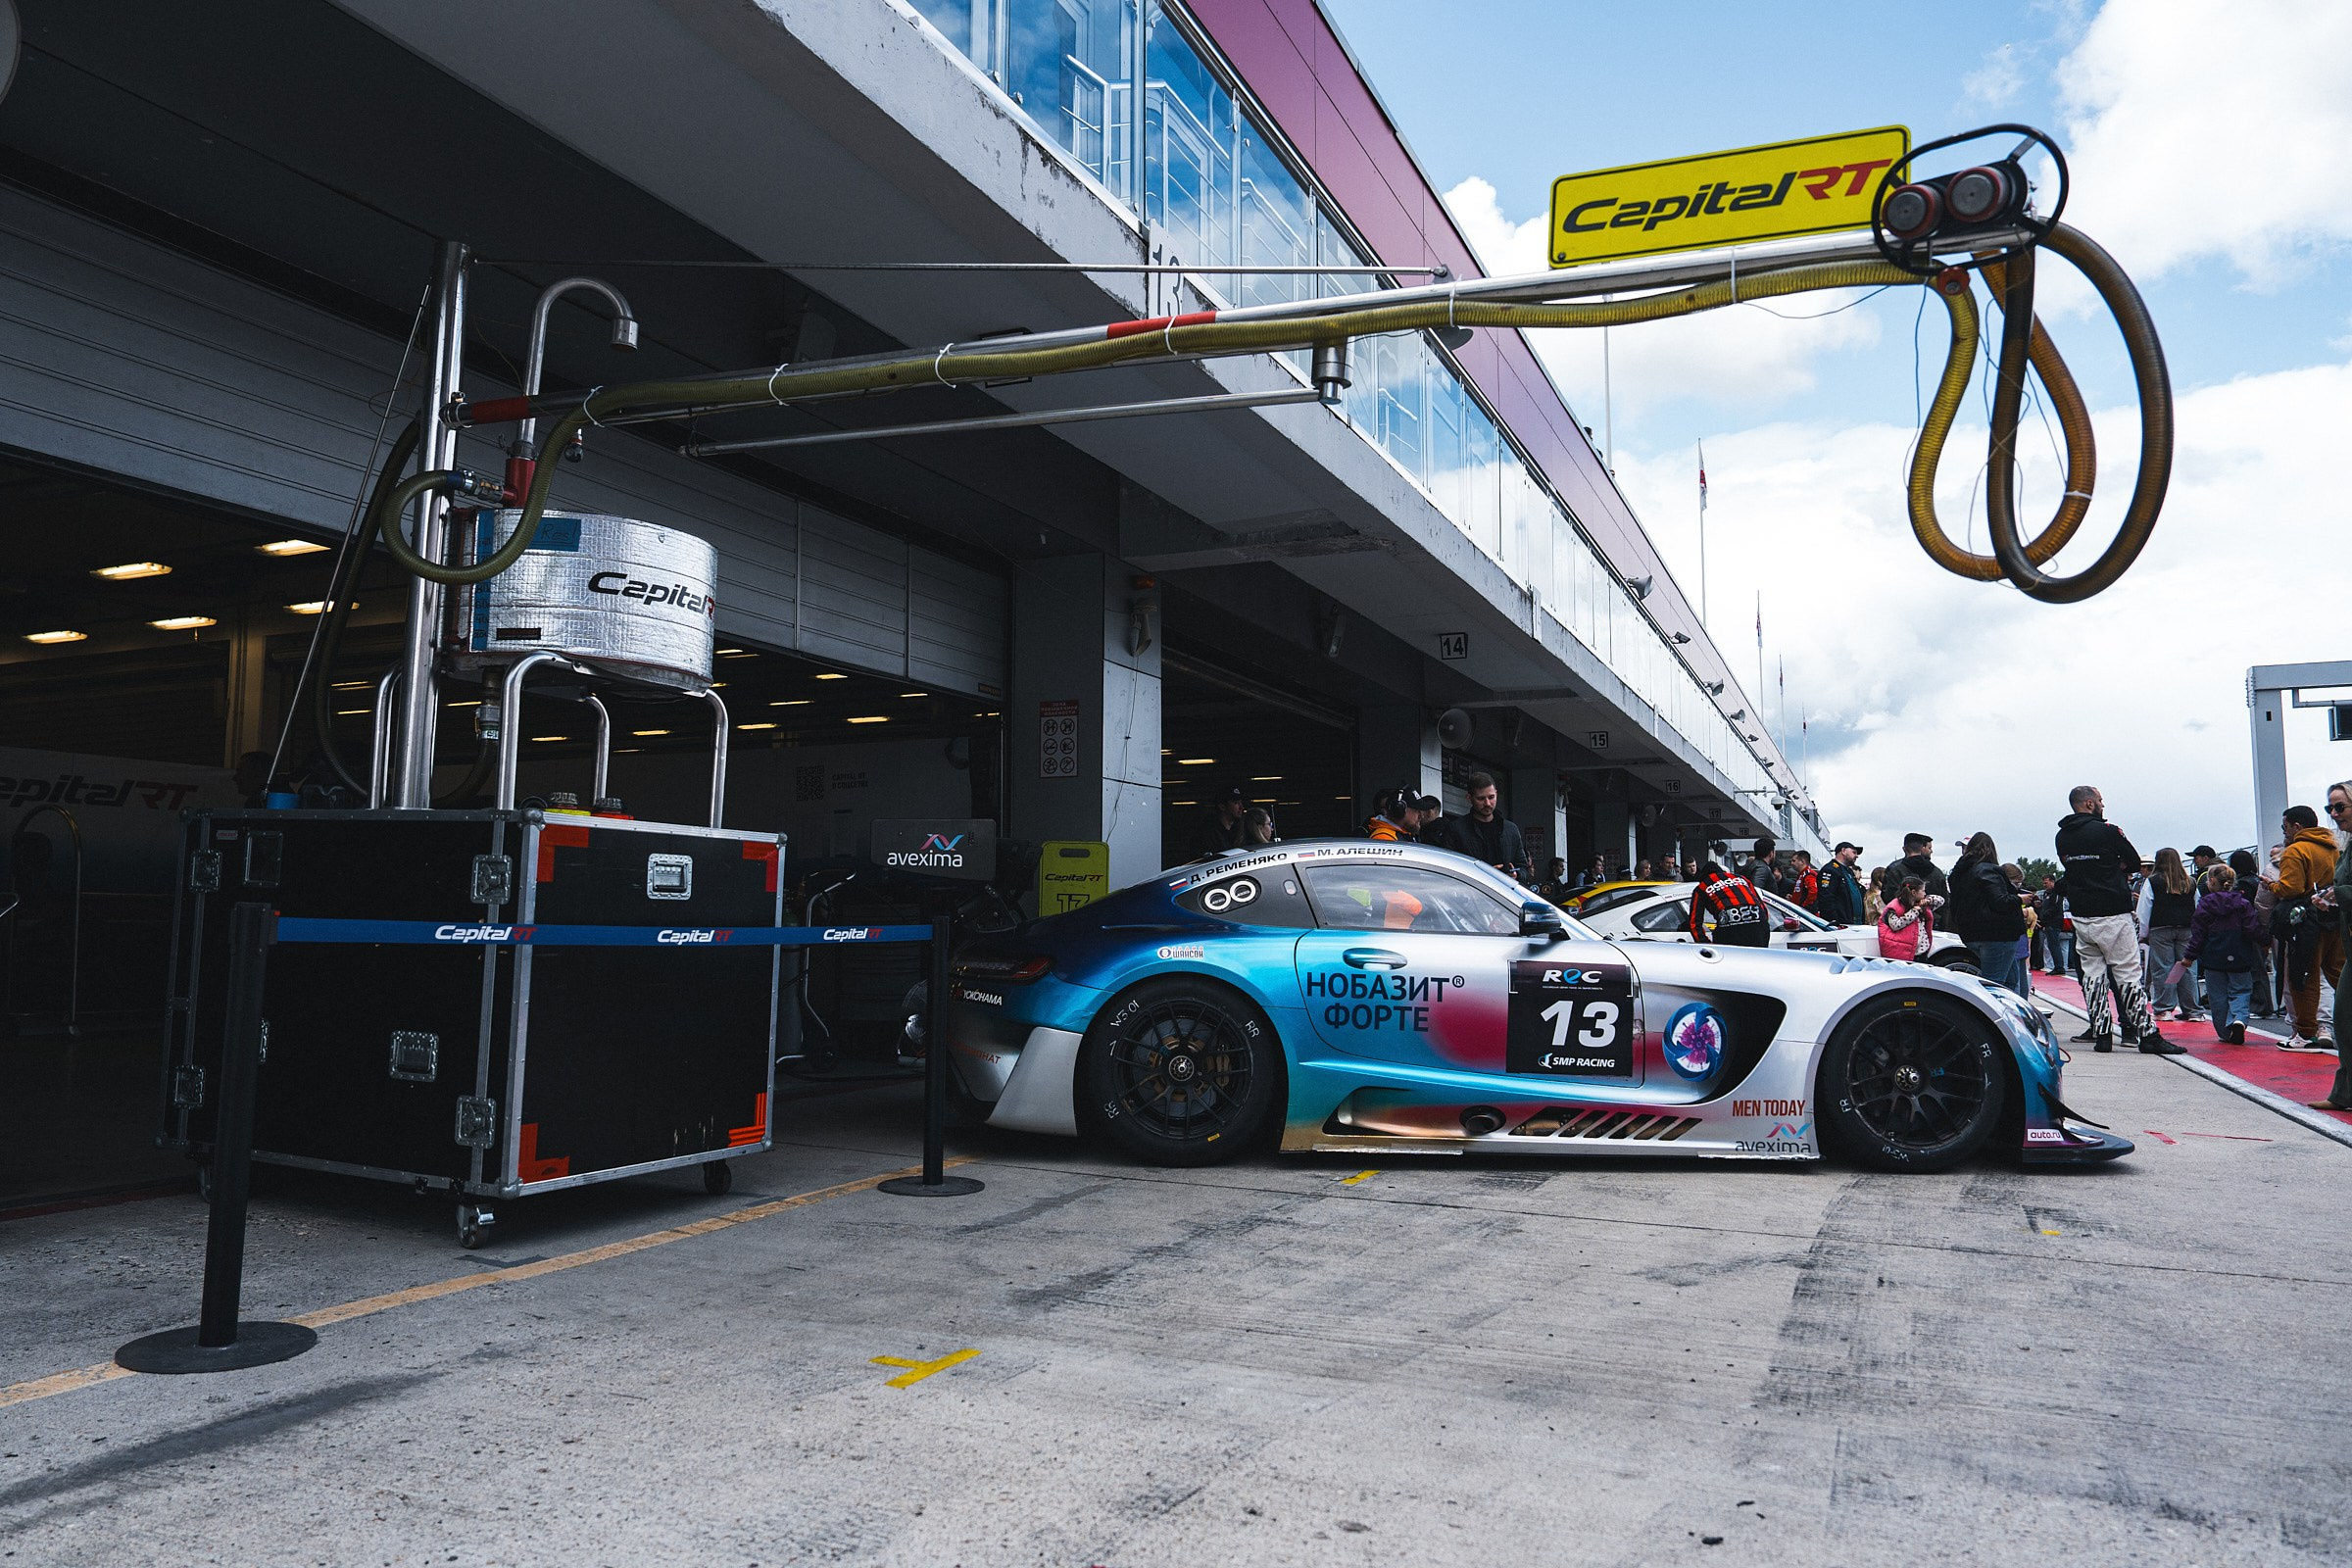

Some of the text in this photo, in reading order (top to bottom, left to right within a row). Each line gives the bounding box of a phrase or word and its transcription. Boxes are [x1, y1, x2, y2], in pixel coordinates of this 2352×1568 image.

[1562, 158, 1893, 233] CapitalRT
[1444, 637, 1463, 656] 14
[1592, 734, 1606, 747] 15
[1667, 782, 1679, 792] 16
[887, 850, 963, 867] avexima
[1336, 848, 1403, 857] АЛЕШИН
[1045, 873, 1103, 883] CapitalRT
[435, 925, 538, 943] CapitalRT
[657, 929, 733, 945] CapitalRT
[823, 928, 883, 942] CapitalRT
[1172, 950, 1203, 958] ШАНСОН
[963, 989, 1003, 1005] YOKOHAMA
[1324, 1003, 1429, 1032] ФОРТЕ
[1541, 1001, 1619, 1048] 13
[1245, 1019, 1261, 1039] RR
[1979, 1042, 1992, 1058] FR
[1552, 1056, 1615, 1067] SMP RACING
[1732, 1100, 1806, 1116] MEN TODAY
[1838, 1098, 1852, 1113] FR
[1735, 1138, 1811, 1153] avexima
